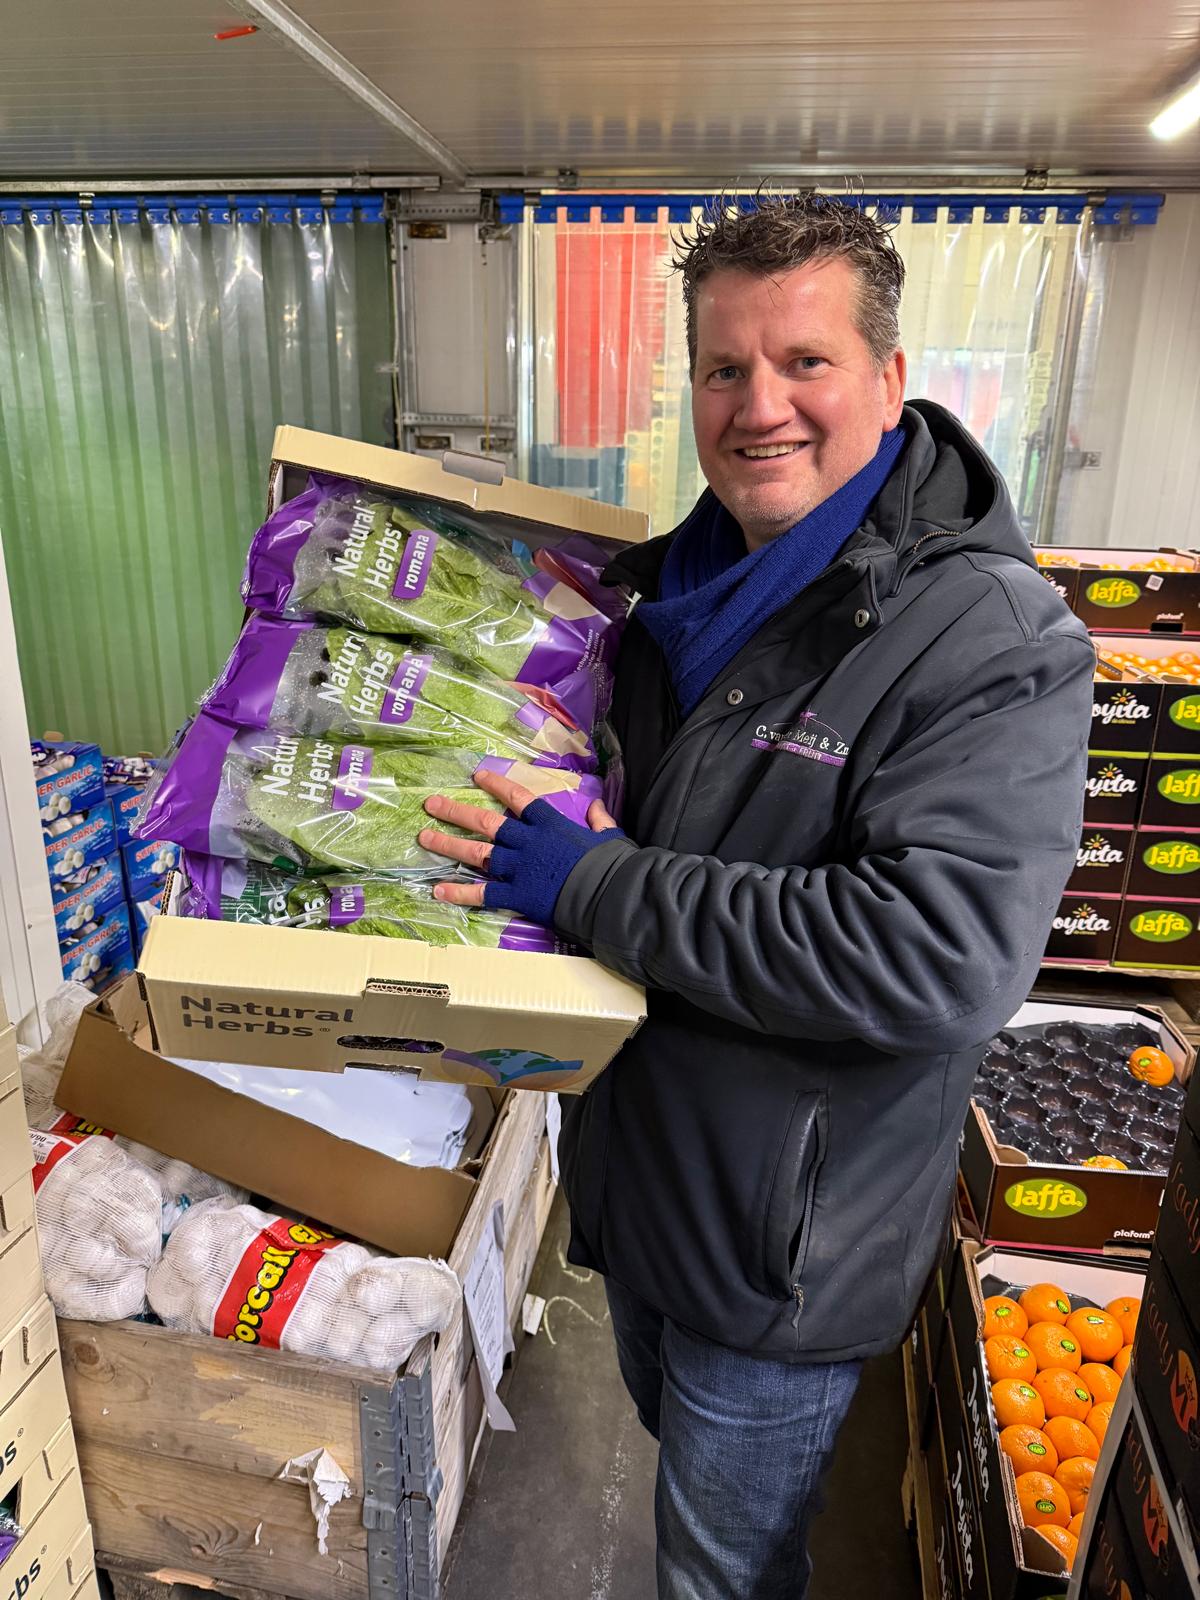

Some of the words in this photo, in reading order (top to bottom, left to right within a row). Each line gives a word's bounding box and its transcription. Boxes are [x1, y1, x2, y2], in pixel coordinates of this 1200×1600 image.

[332, 506, 376, 578] Natural
[404, 534, 431, 590] romana
[1091, 581, 1138, 602] Jaffa
[391, 658, 424, 717] romana
[1091, 699, 1152, 724] oyita
[820, 737, 830, 750] &
[56, 764, 94, 788] GARLIC
[1084, 774, 1138, 798] yita
[1163, 774, 1200, 798] Jaff
[71, 818, 105, 843] GARLIC
[1076, 844, 1124, 867] yita
[1149, 845, 1200, 869] Jaffa
[1052, 913, 1111, 935] oyita
[1136, 914, 1189, 936] Jaffa
[181, 995, 353, 1023] Natural
[1011, 1184, 1083, 1211] Jaffa
[226, 1245, 300, 1344] orcall
